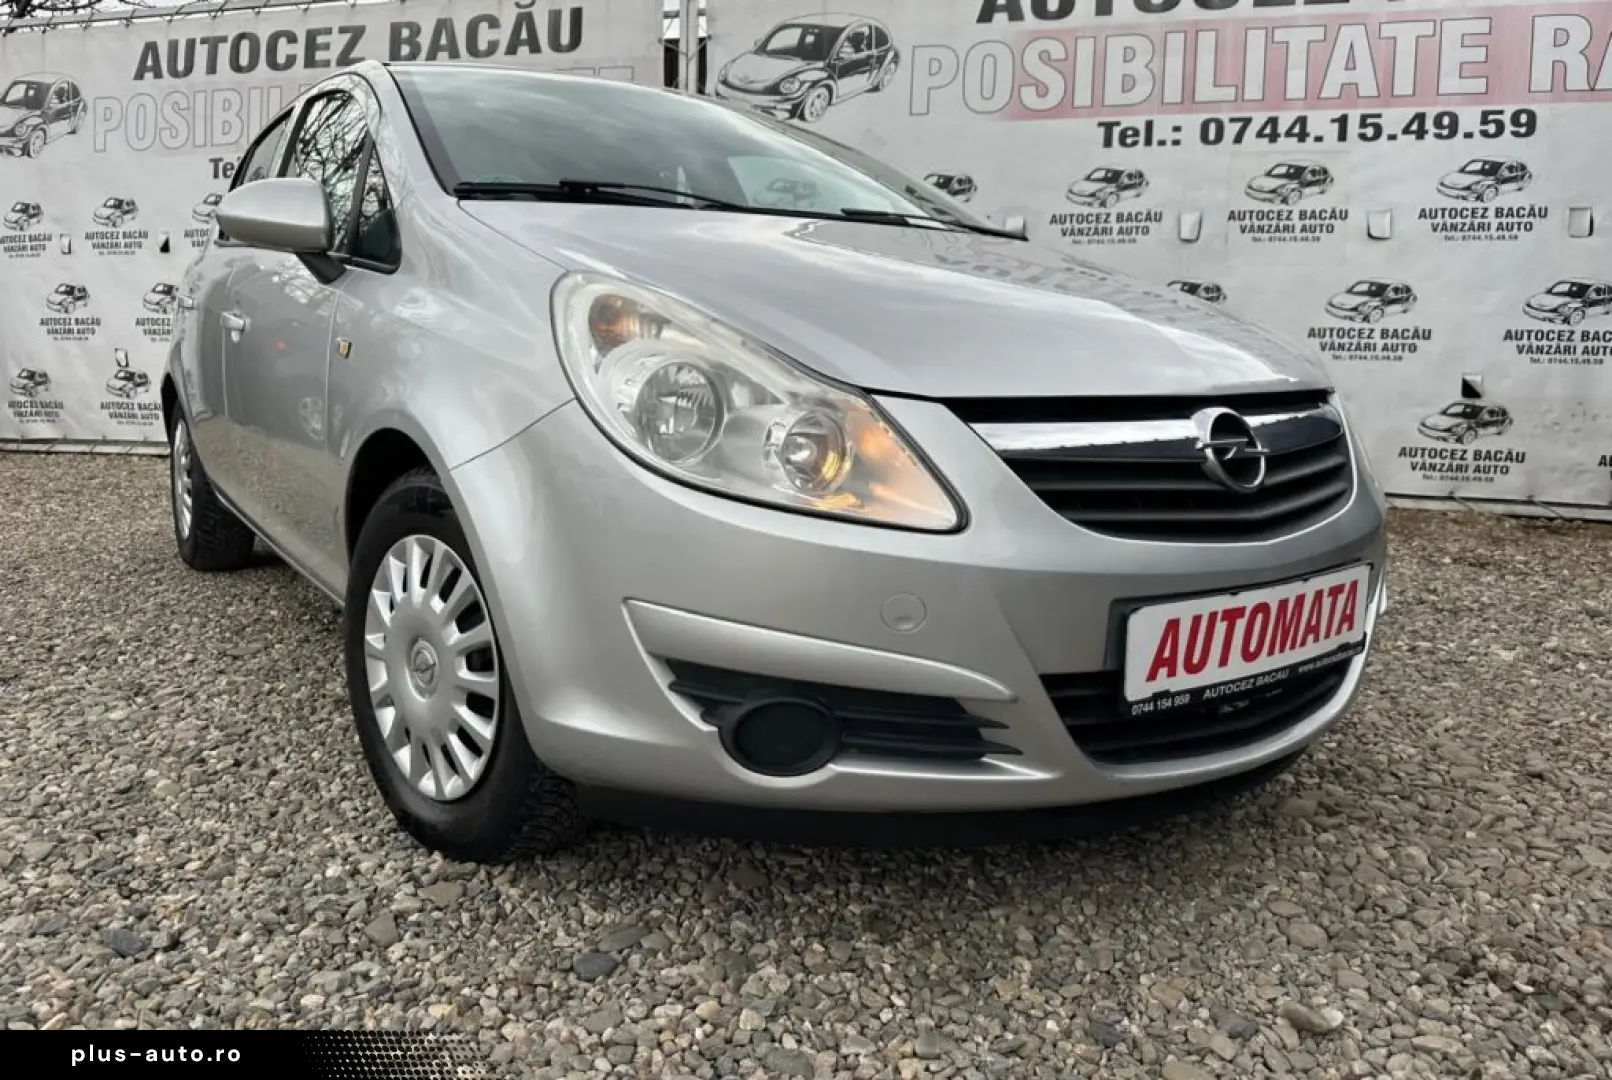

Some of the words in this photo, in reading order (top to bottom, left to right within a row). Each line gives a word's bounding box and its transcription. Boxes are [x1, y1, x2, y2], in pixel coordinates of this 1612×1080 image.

[133, 24, 367, 81] AUTOCEZ
[388, 0, 583, 62] BACĂU
[910, 17, 1492, 118] POSIBILITATE
[1097, 119, 1183, 149] Tel.:
[1199, 107, 1538, 147] 0744.15.49.59
[1049, 212, 1112, 226] AUTOCEZ
[1228, 208, 1293, 222] AUTOCEZ
[1418, 207, 1489, 220] AUTOCEZ
[1117, 225, 1150, 237] AUTO
[1300, 223, 1335, 234] AUTO
[1495, 221, 1534, 232] AUTO
[1307, 327, 1376, 339] AUTOCEZ
[1503, 329, 1576, 341] AUTOCEZ
[1381, 342, 1418, 353] AUTO
[1581, 344, 1612, 356] AUT
[1398, 447, 1468, 461] AUTOCEZ
[1472, 463, 1510, 475] AUTO
[1145, 579, 1359, 683] AUTOMATA
[1131, 701, 1155, 716] 0744
[1202, 678, 1254, 700] AUTOCEZ
